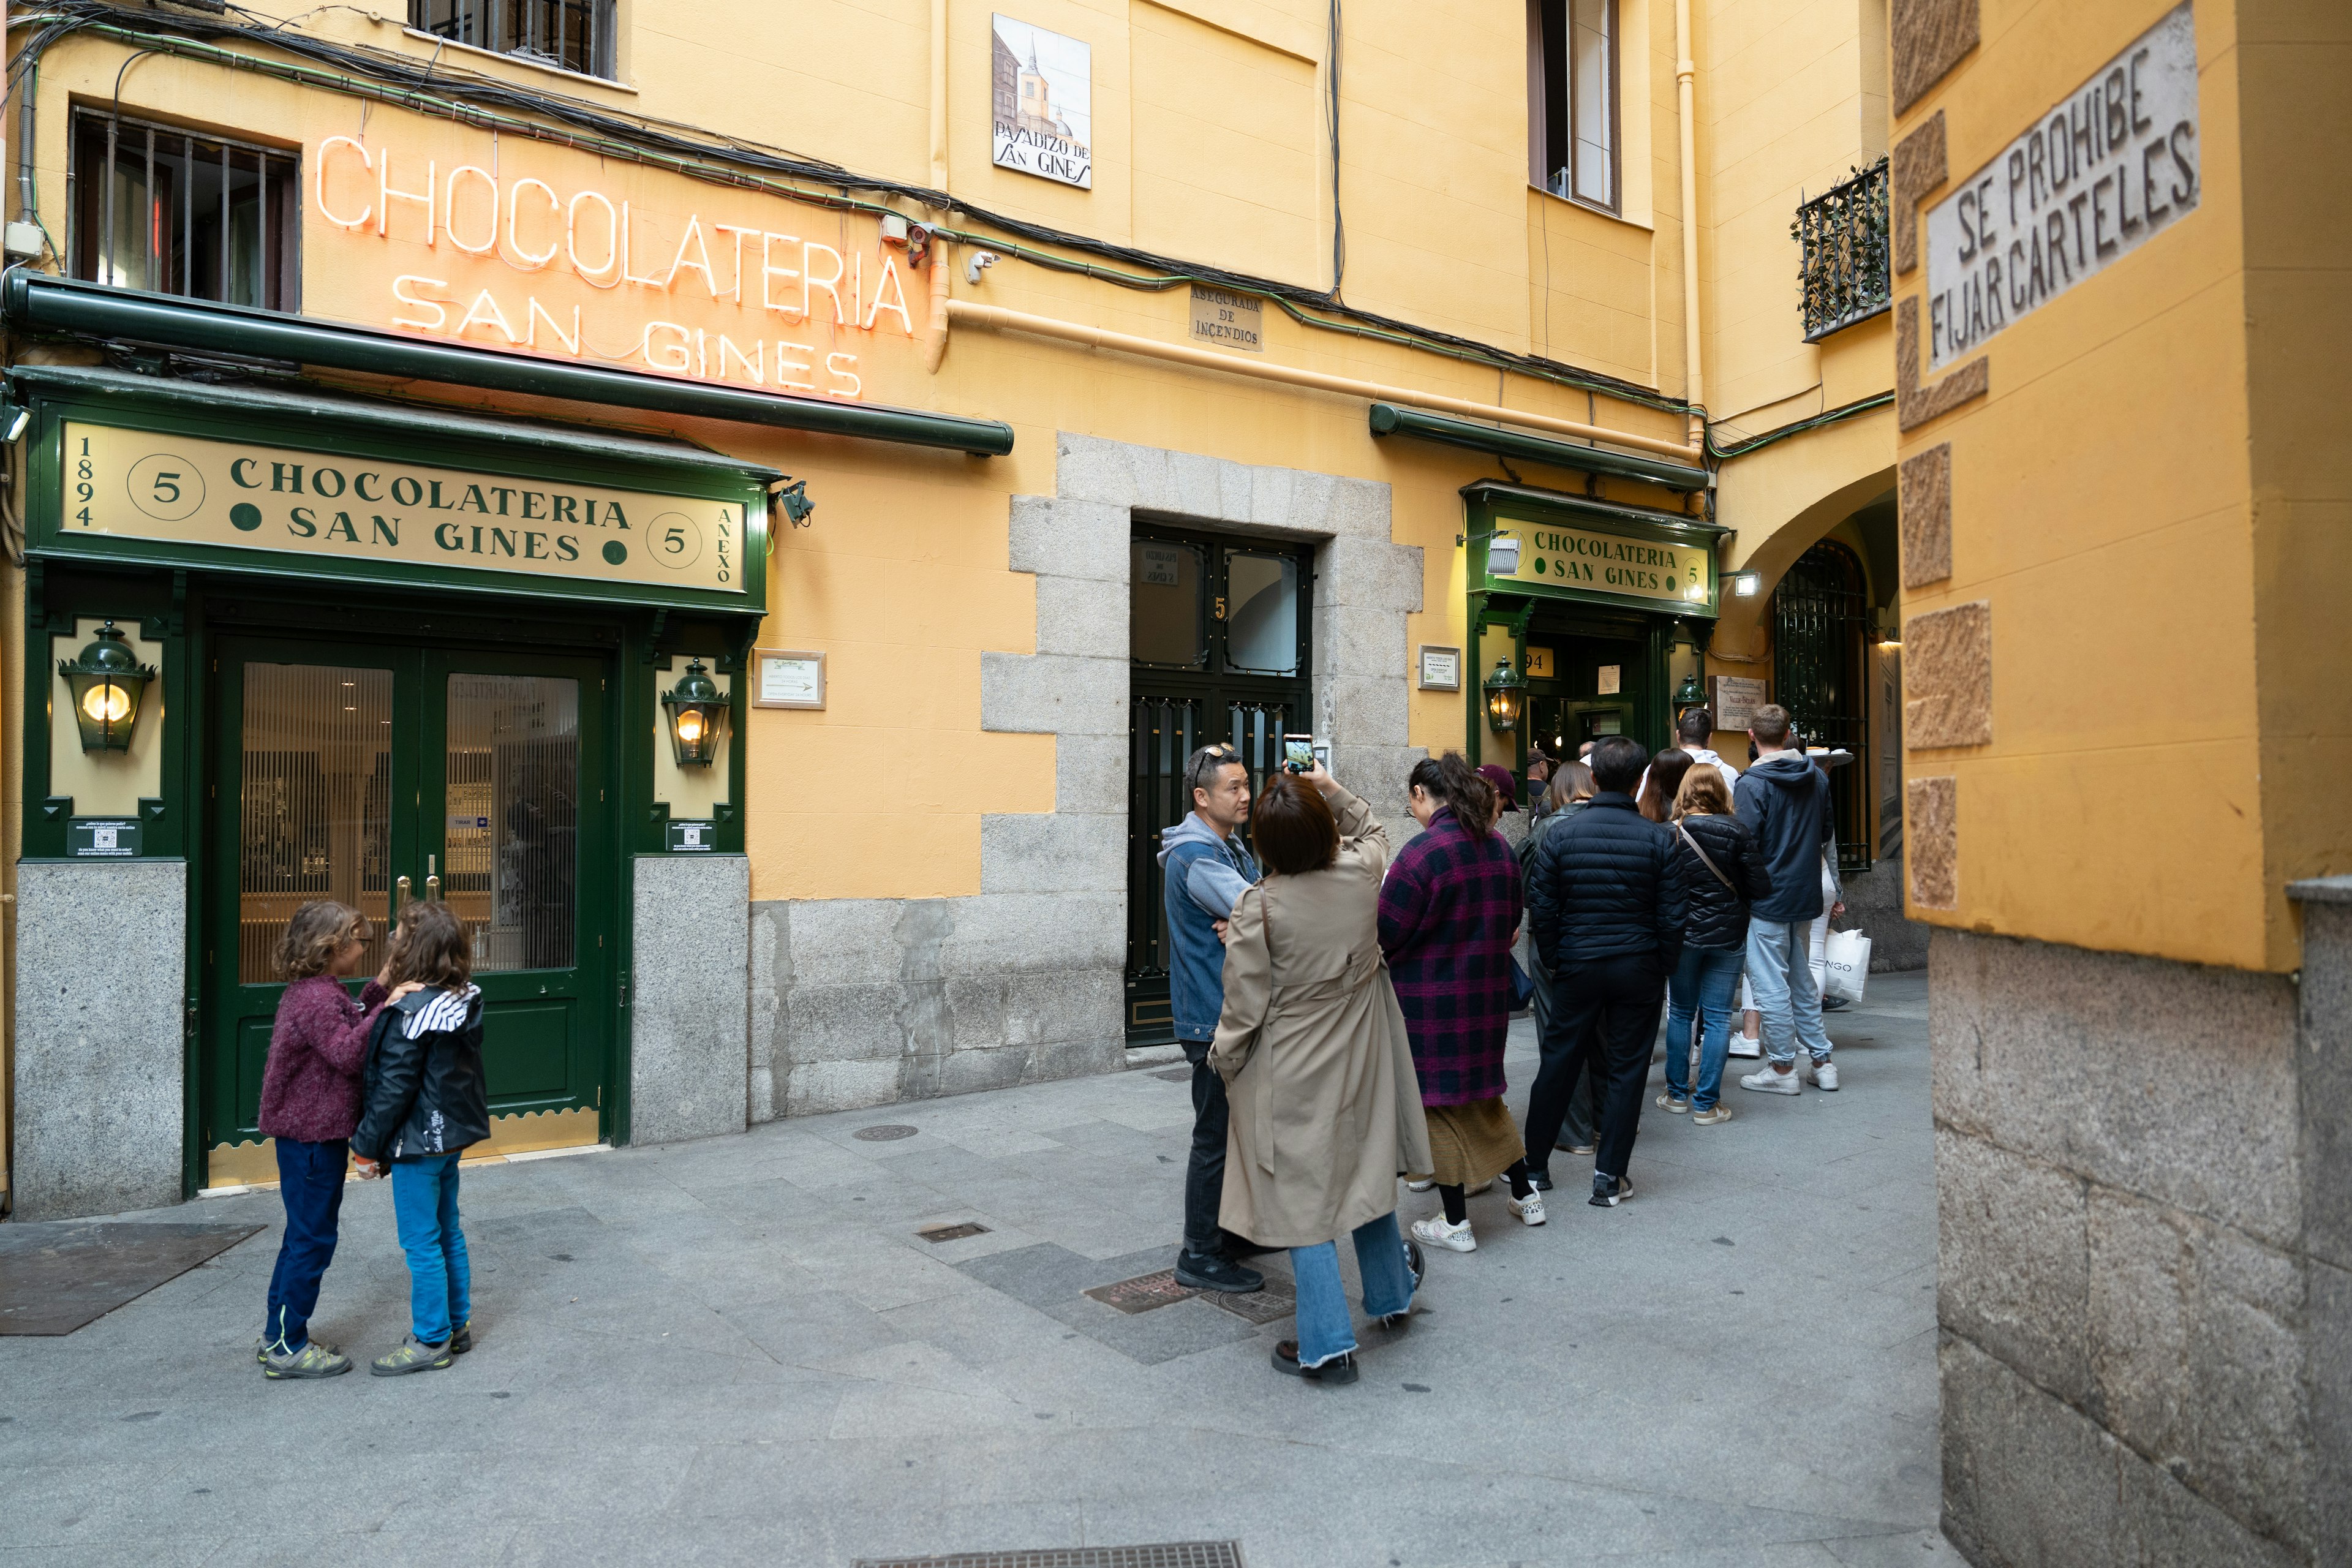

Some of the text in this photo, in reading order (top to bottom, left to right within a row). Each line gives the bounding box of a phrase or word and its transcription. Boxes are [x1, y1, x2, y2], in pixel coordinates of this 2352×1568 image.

[995, 121, 1090, 160] PASADIZO DE
[1956, 47, 2152, 264] SE PROHIBE
[995, 143, 1091, 183] SAN GINES
[315, 134, 911, 334] CHOCOLATERIA
[1929, 120, 2195, 359] FIJAR CARTELES
[1191, 287, 1260, 312] ASEGURADA
[1219, 308, 1234, 322] DE
[392, 274, 861, 397] SAN GINES
[1196, 320, 1257, 344] INCENDIOS
[76, 437, 94, 526] 1894
[153, 472, 181, 503] 5
[230, 458, 631, 530] CHOCOLATERIA
[287, 507, 580, 562] SAN GINES
[665, 528, 685, 554] 5
[717, 508, 732, 582] ANEXO
[1534, 531, 1677, 569] CHOCOLATERIA
[1553, 560, 1659, 590] SAN GINES
[1689, 567, 1697, 584] 5
[1215, 597, 1225, 619] 5
